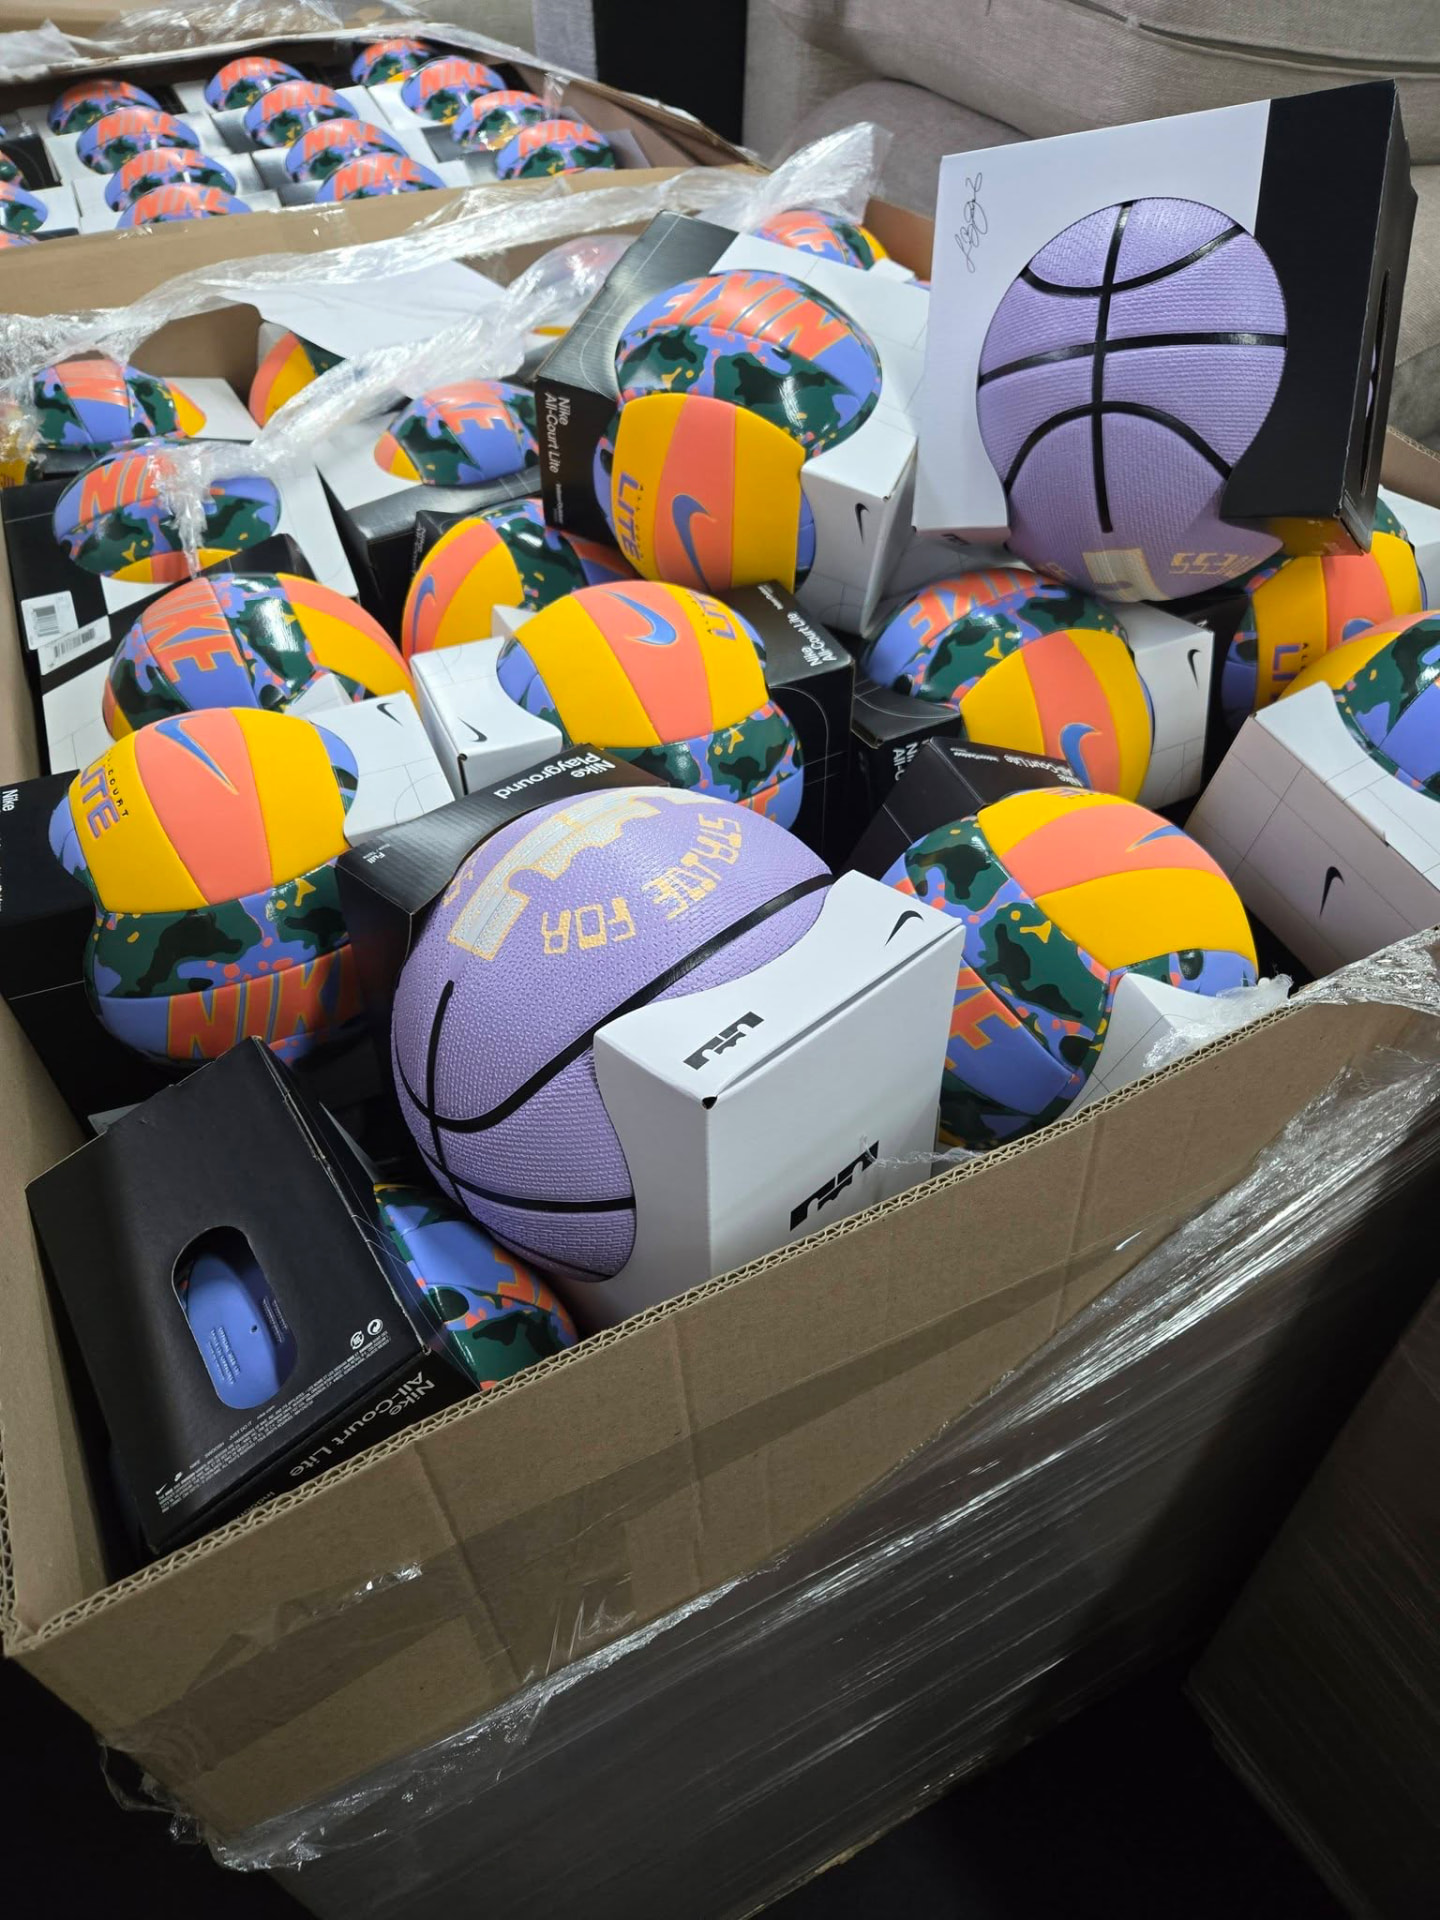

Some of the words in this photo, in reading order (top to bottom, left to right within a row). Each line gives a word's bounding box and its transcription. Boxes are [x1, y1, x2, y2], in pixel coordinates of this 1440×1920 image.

[304, 119, 383, 162] NIKE
[334, 153, 423, 202] NIKE
[134, 184, 230, 226] NIKE
[648, 272, 856, 361] NIKE
[544, 392, 560, 451] All-Court
[557, 396, 571, 426] Nike
[549, 447, 562, 474] Lite
[617, 470, 642, 561] LITE
[801, 646, 824, 667] Nike
[492, 750, 602, 801] Playground
[571, 758, 616, 779] Nike
[2, 788, 19, 812] Nike
[366, 851, 387, 866] Full
[541, 896, 638, 956] FOR
[331, 1371, 423, 1446] All-Court
[388, 1379, 435, 1416] Nike
[289, 1445, 334, 1478] Lite
